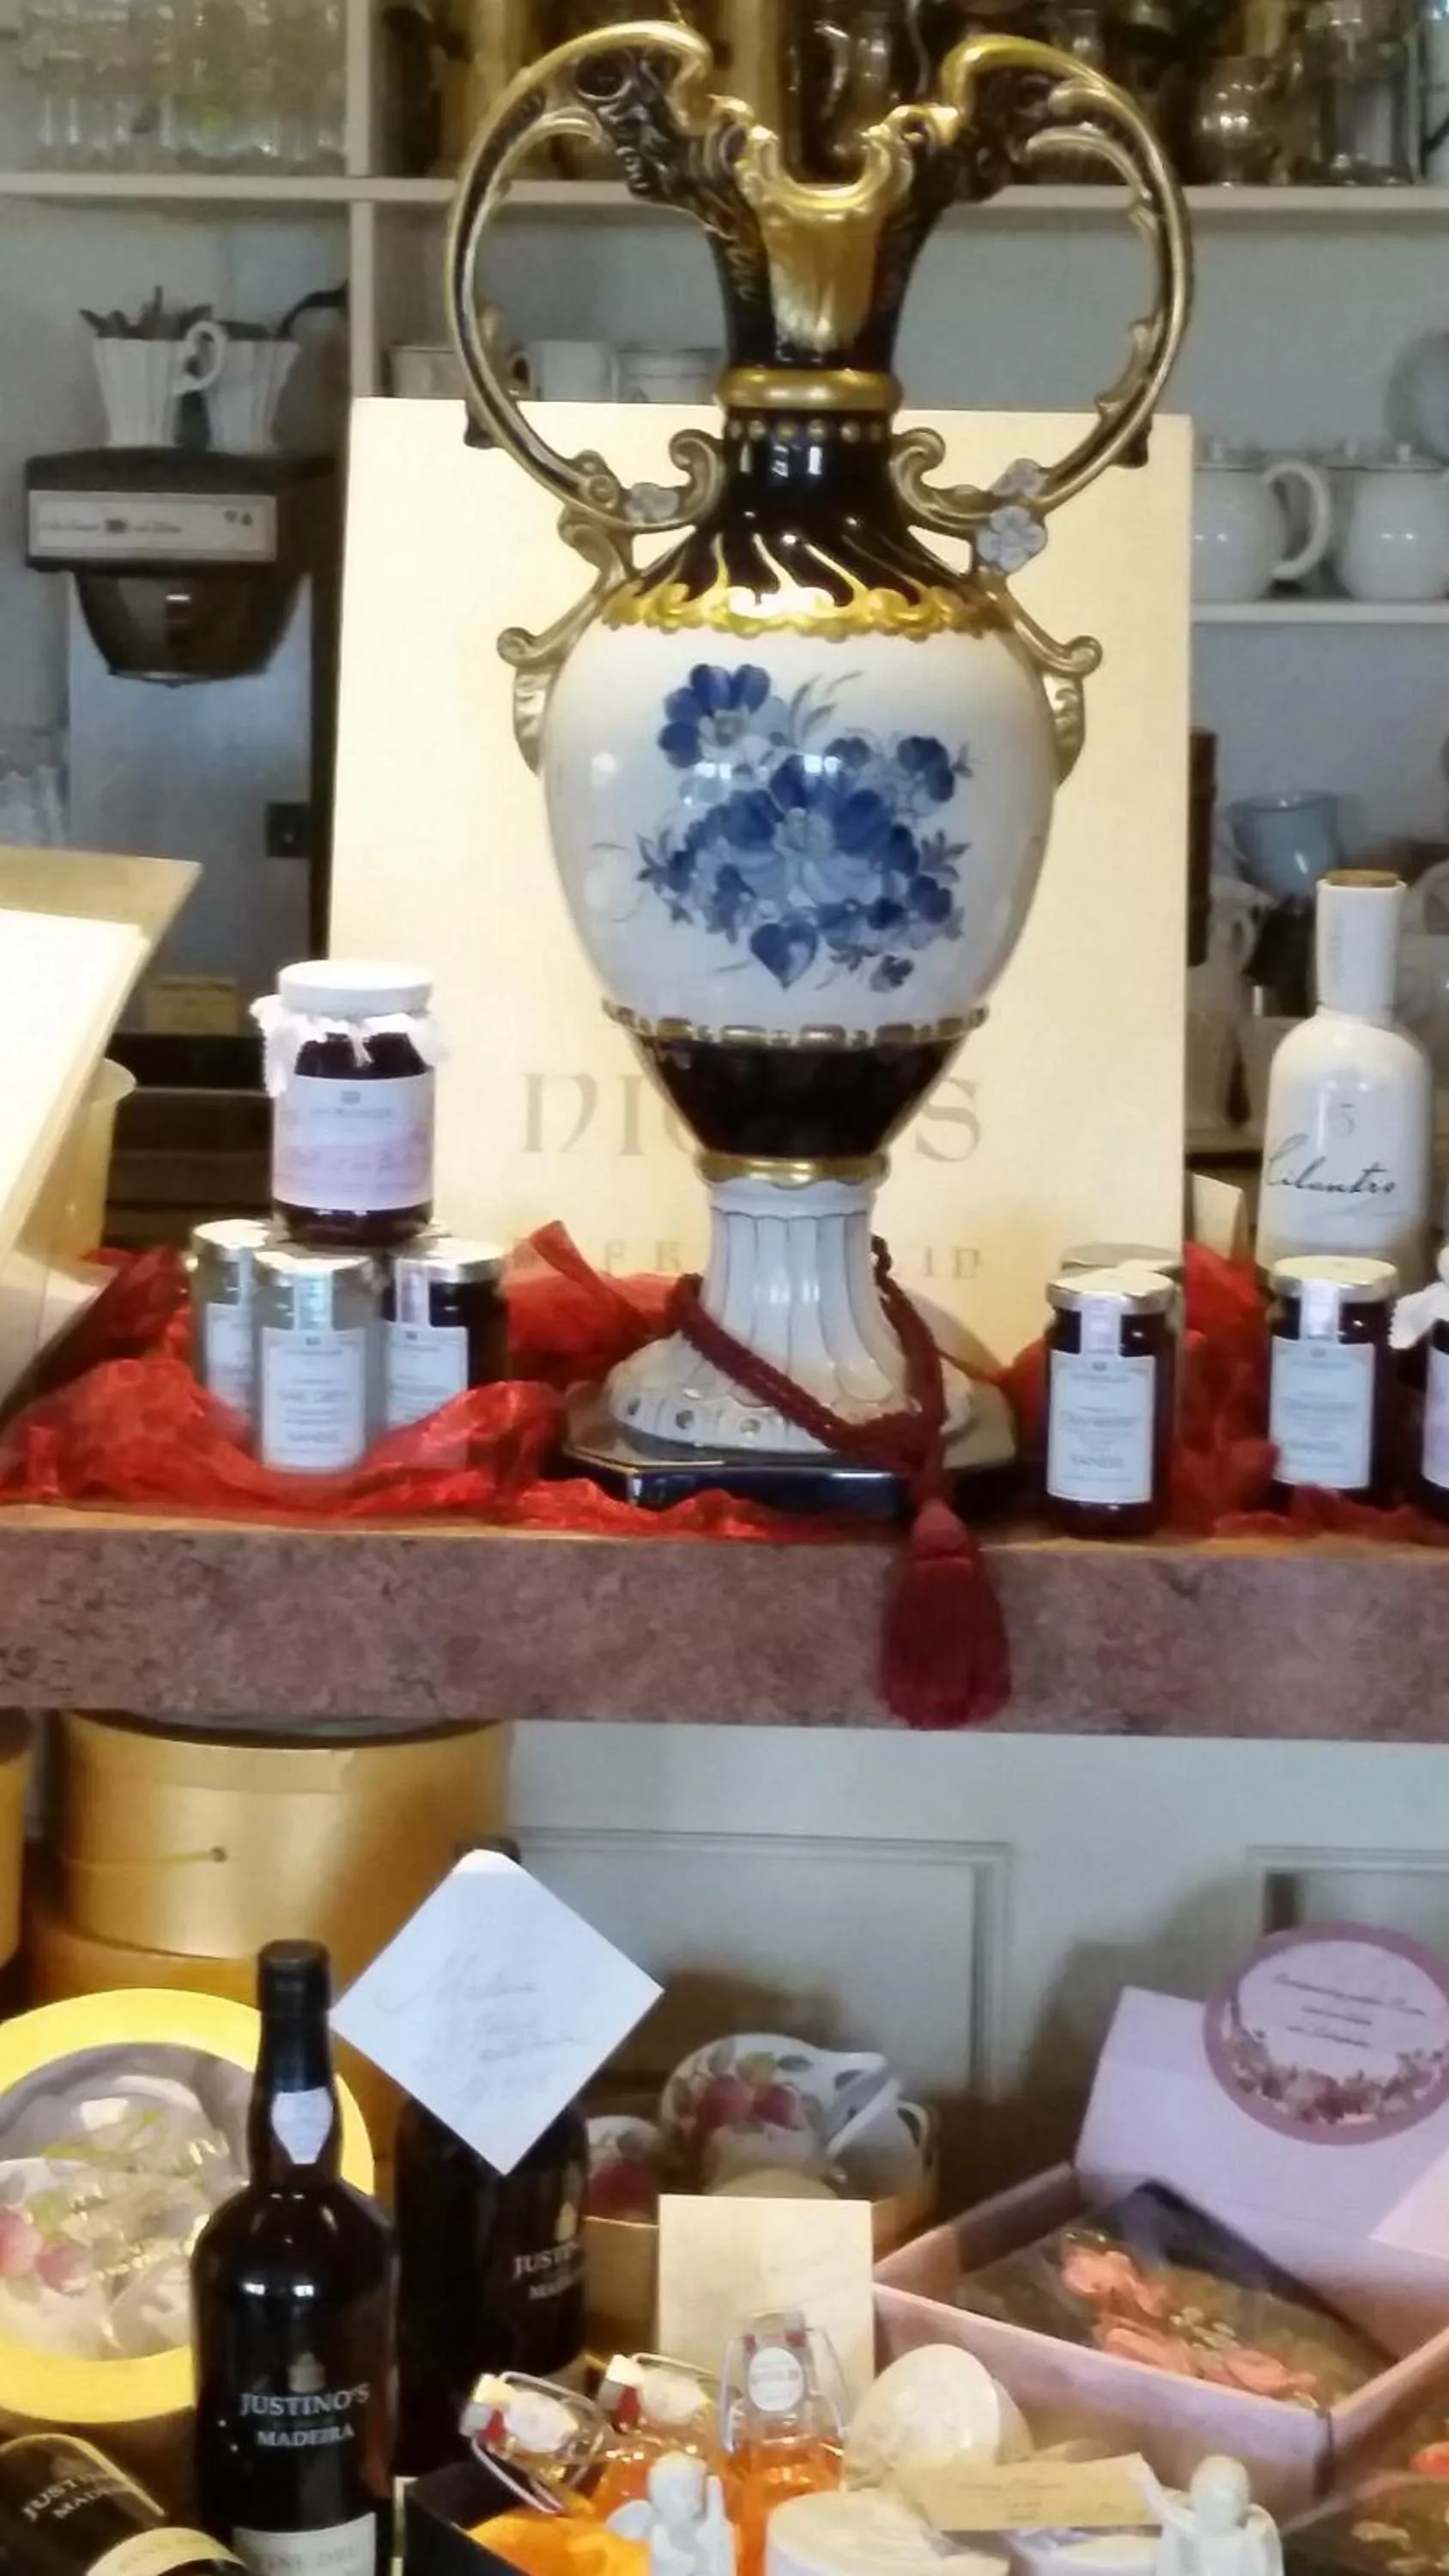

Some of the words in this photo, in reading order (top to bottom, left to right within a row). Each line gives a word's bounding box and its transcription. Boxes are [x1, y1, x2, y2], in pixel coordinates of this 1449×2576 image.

[1266, 1133, 1397, 1194] Cilantro
[239, 2381, 371, 2417] JUSTINO'S
[256, 2422, 355, 2448] MADEIRA
